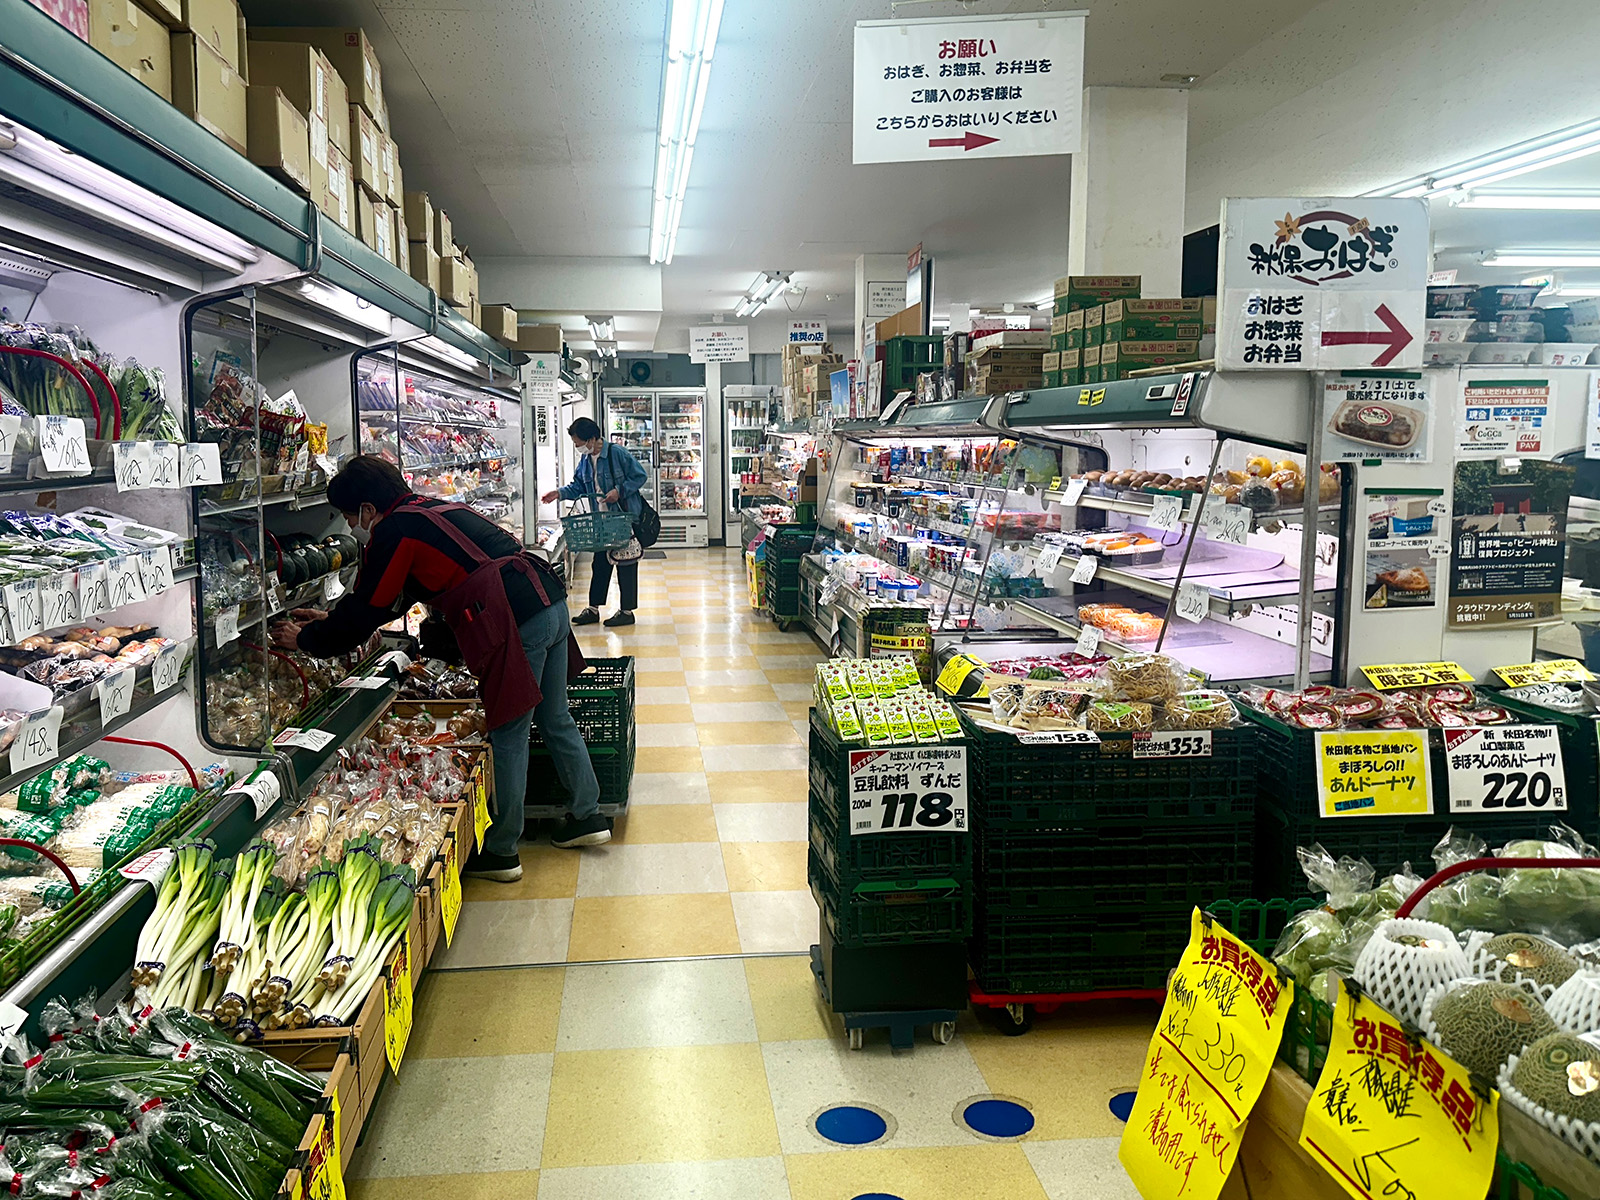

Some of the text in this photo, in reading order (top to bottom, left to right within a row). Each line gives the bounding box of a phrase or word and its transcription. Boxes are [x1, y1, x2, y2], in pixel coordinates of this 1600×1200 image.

[938, 39, 997, 59] お願い
[884, 59, 1052, 80] おはぎ、お惣菜、お弁当を
[911, 86, 1022, 104] ご購入のお客様は
[876, 110, 1057, 130] こちらからおはいりください
[1248, 295, 1303, 315] おはぎ
[789, 332, 824, 342] 推奨の店
[1244, 320, 1303, 341] お惣菜
[1243, 343, 1302, 363] お弁当
[1346, 391, 1426, 400] 販売終了になります
[1468, 410, 1487, 419] 現金
[1500, 408, 1540, 416] クレジットカード
[537, 405, 547, 443] 三角油揚げ
[1478, 538, 1558, 548] 世界唯一の「ビール神社」
[1478, 549, 1535, 558] 復興プロジェクト
[1377, 671, 1460, 686] 限定入荷
[1055, 733, 1091, 742] 158
[1483, 730, 1495, 740] 新
[1169, 737, 1204, 755] 353
[1325, 744, 1418, 756] 秋田新名物ご当地パン
[1480, 741, 1525, 751] 山口製菓店
[869, 761, 945, 773] キッコーマンソイフーズ
[853, 773, 961, 793] 豆乳飲料 ずんだ
[1330, 775, 1416, 793] あんドーナツ
[1481, 771, 1552, 809] 220
[881, 792, 954, 829] 118
[1200, 934, 1280, 1018] お買得品
[1195, 1022, 1246, 1083] 330
